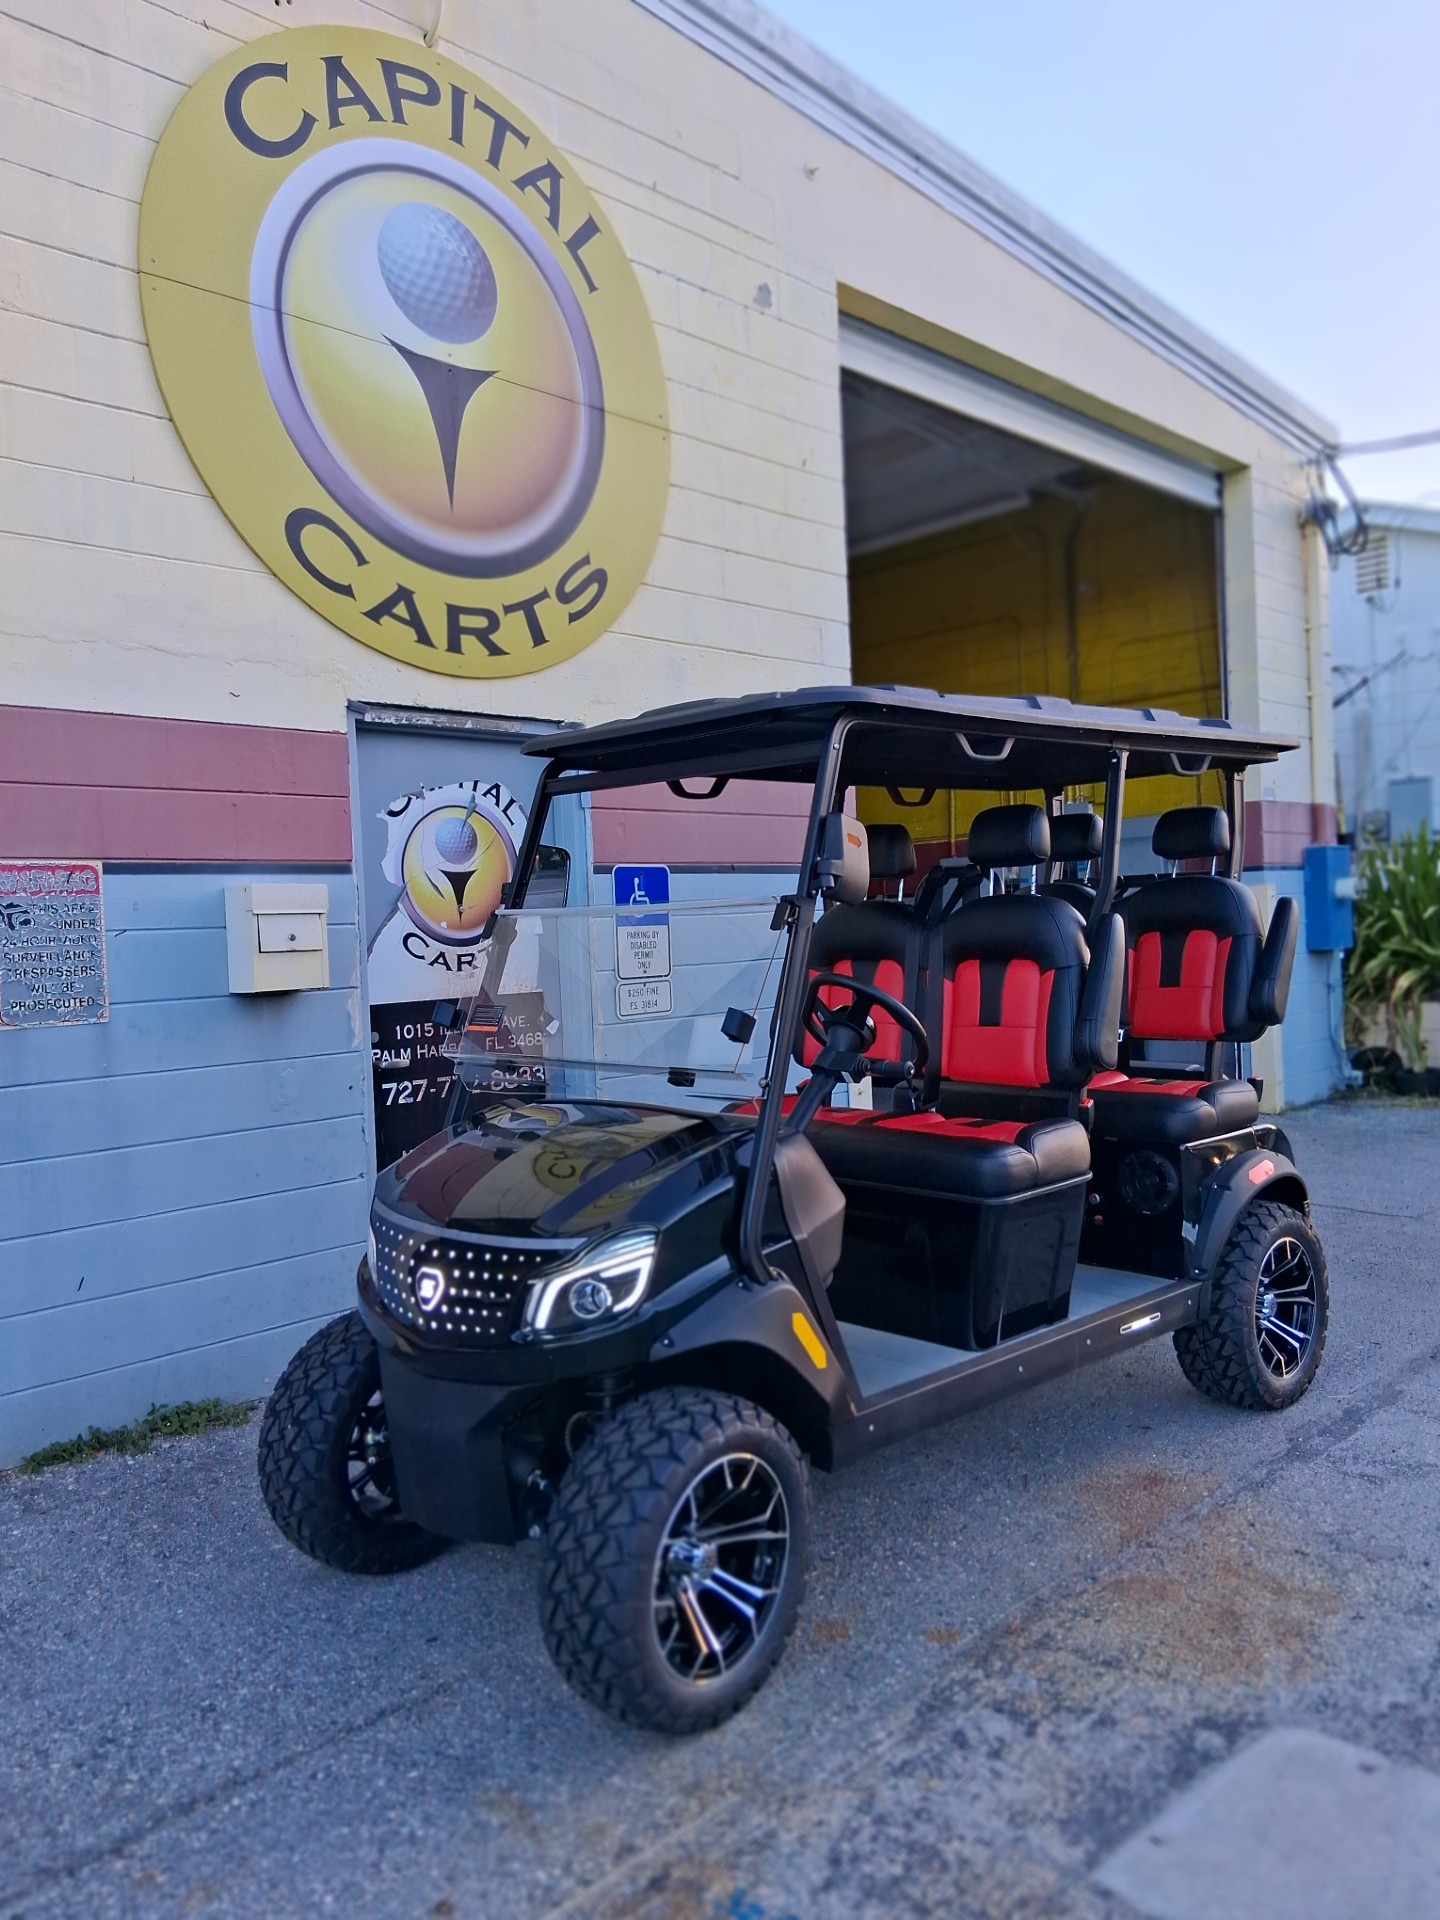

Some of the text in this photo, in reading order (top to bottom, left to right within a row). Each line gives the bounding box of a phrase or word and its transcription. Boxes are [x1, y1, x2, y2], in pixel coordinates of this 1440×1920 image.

[224, 56, 604, 295] CAPITAL
[284, 507, 609, 658] CARTS
[57, 919, 96, 930] UNDER
[626, 930, 660, 940] PARKING BY
[3, 936, 17, 948] 24
[630, 941, 657, 950] DISABLED
[634, 951, 654, 960] PERMIT
[637, 961, 652, 970] ONLY
[628, 986, 660, 998] $250 FINE
[11, 996, 95, 1012] PROSECUTED
[395, 1022, 434, 1040] 1015
[501, 1015, 530, 1030] AVE.
[372, 1048, 412, 1063] PALM
[485, 1037, 504, 1051] FL
[508, 1031, 547, 1049] 3468
